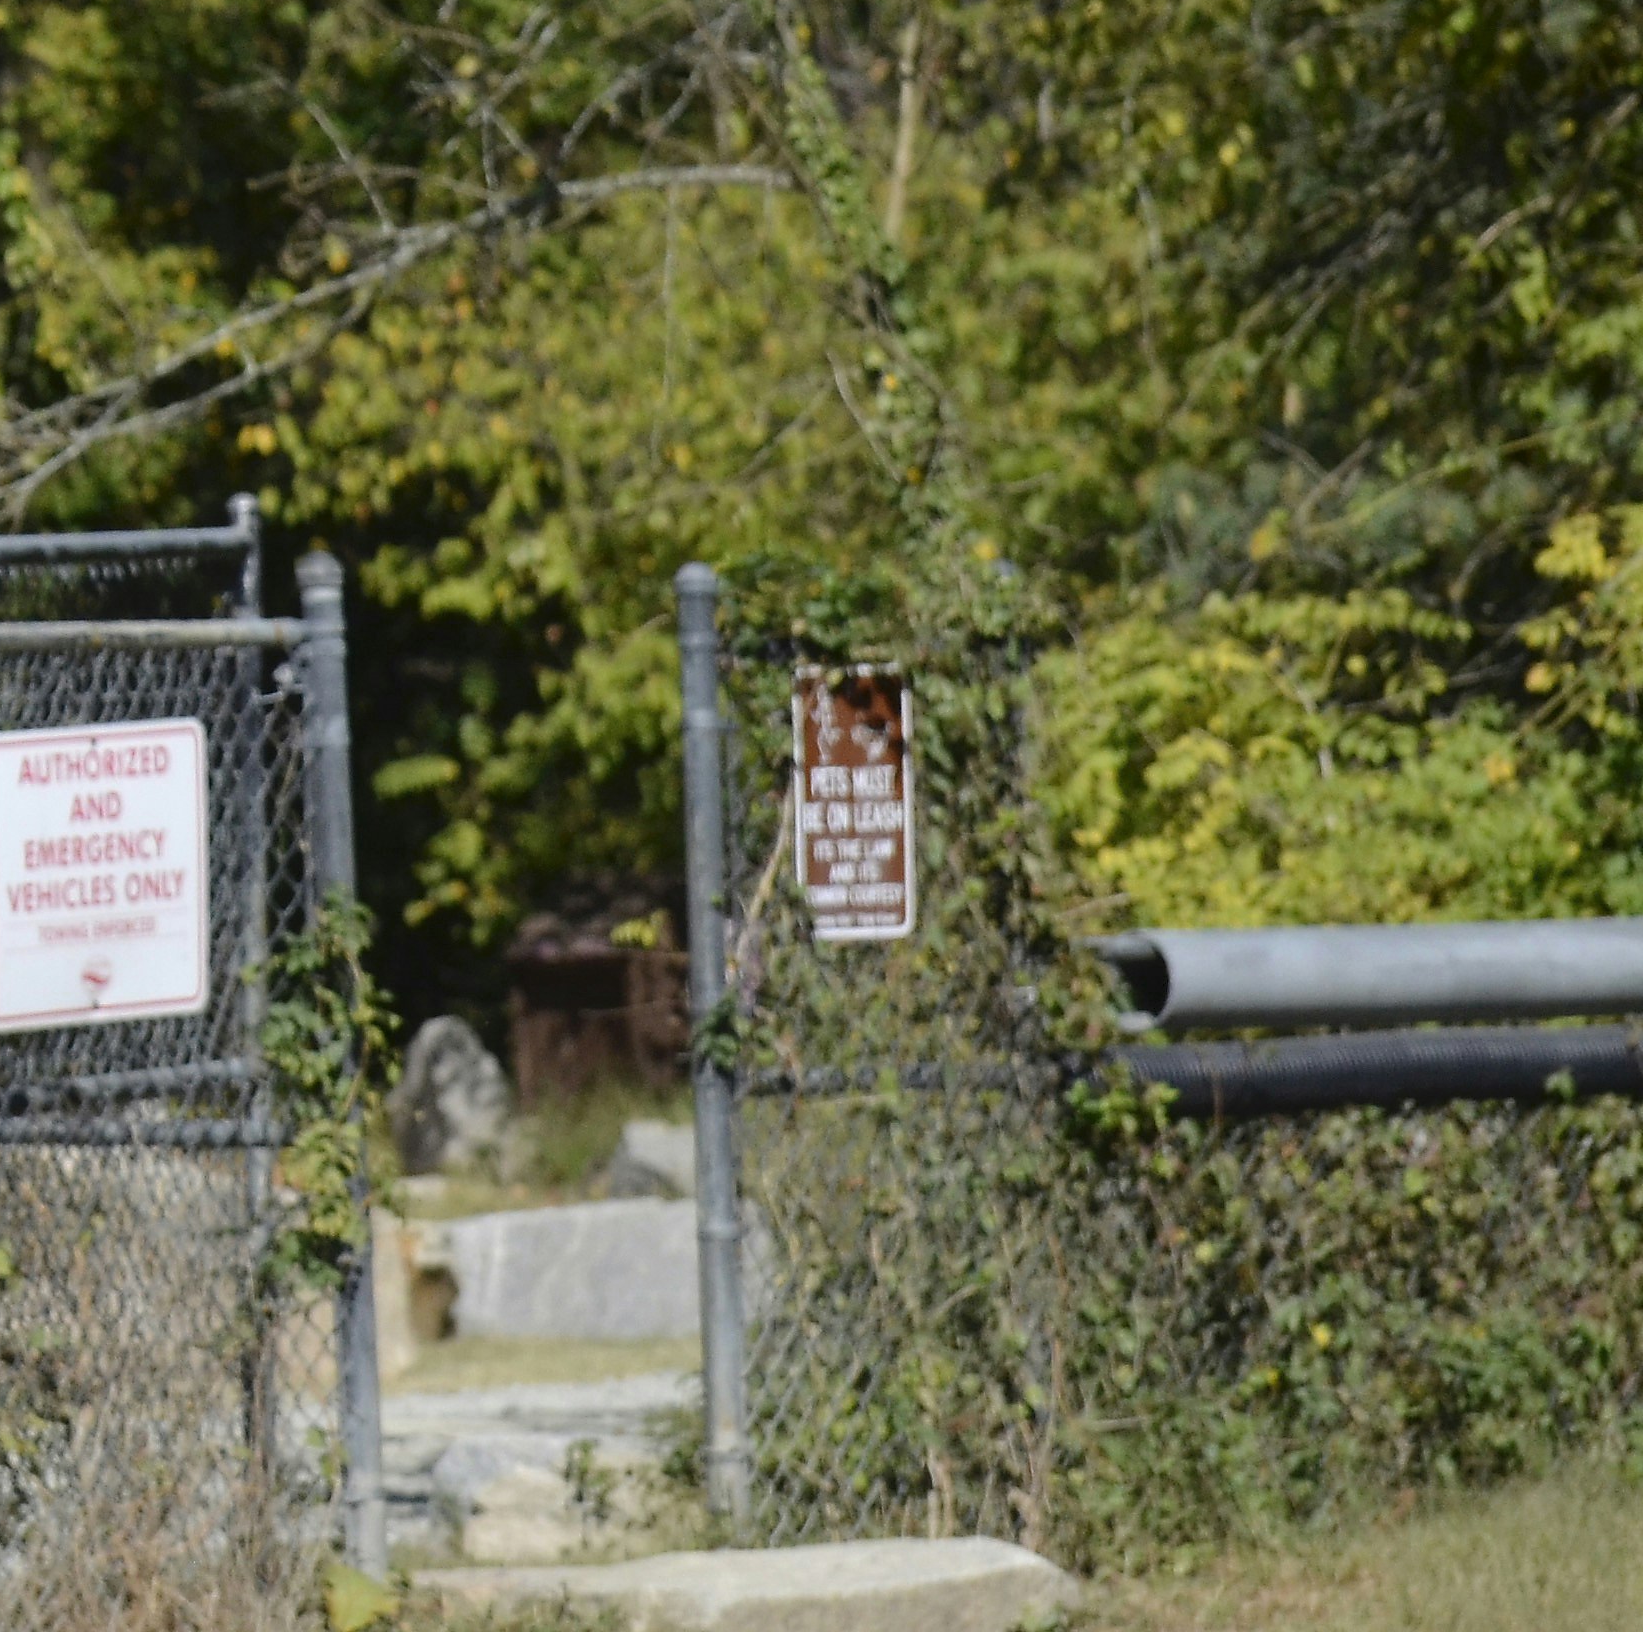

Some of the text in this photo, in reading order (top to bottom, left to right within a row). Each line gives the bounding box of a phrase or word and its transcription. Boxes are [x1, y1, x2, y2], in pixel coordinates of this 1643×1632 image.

[18, 745, 170, 784] AUTHORIZED
[69, 790, 122, 821] AND
[23, 829, 166, 869] EMERGENCY
[7, 870, 186, 913] VEHICLES ONLY
